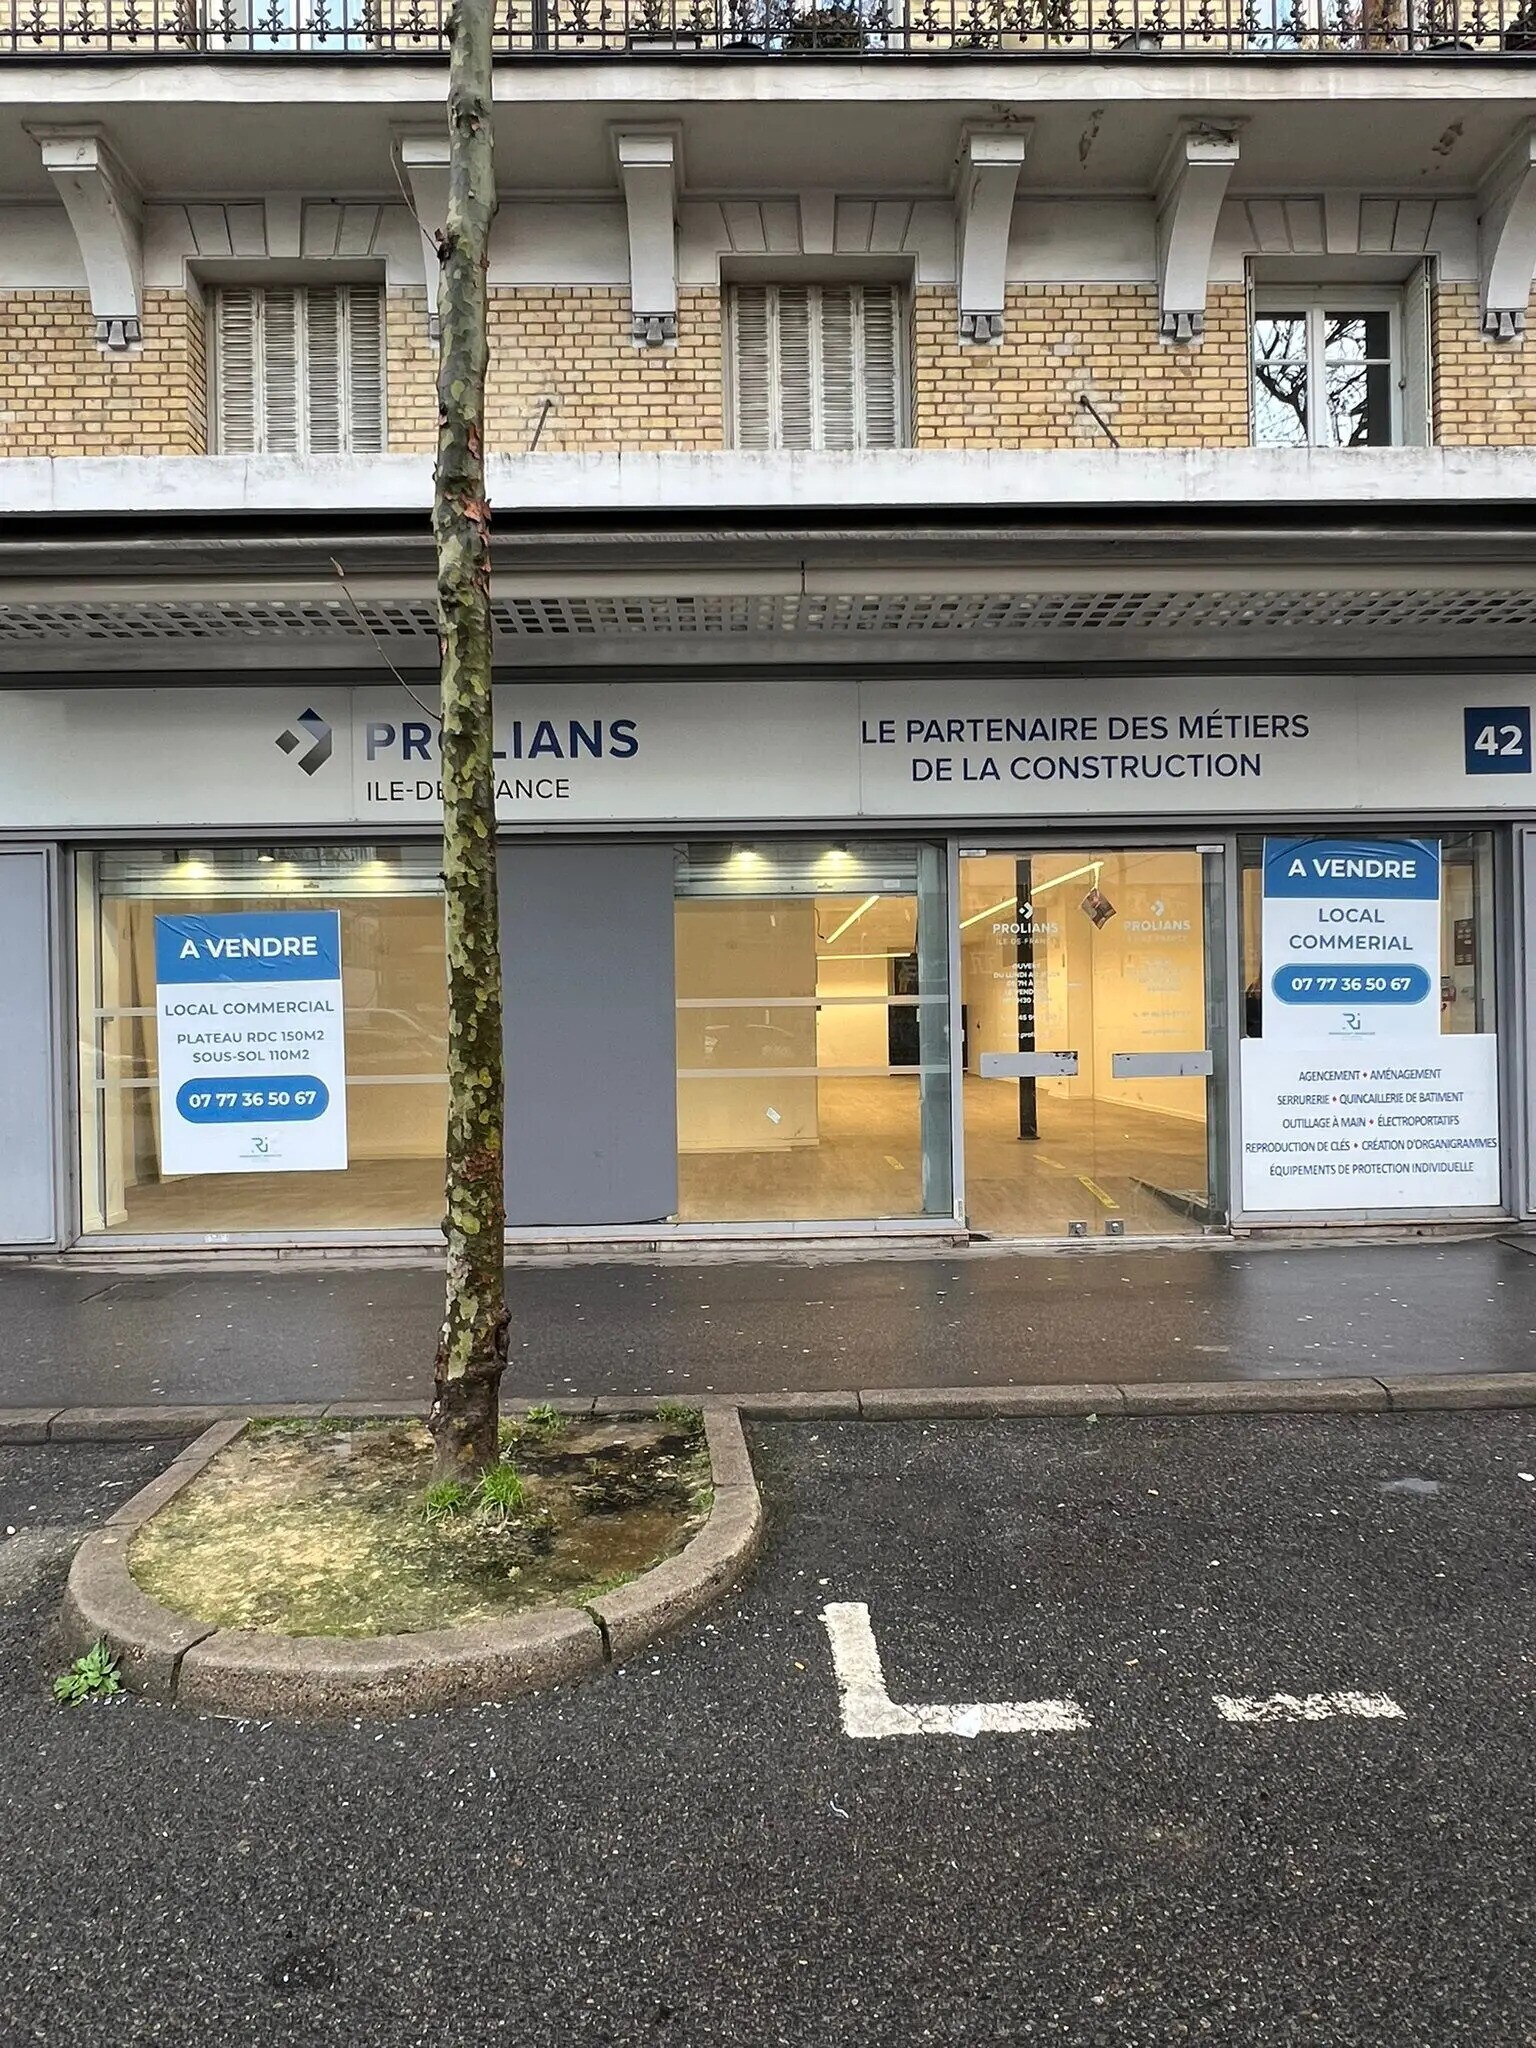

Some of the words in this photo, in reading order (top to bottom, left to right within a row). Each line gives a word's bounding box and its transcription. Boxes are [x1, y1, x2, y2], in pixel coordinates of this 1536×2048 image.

[861, 719, 897, 744] LE
[905, 717, 1098, 744] PARTENAIRE
[1108, 715, 1169, 741] DES
[1178, 709, 1310, 739] MÉTIERS
[1474, 725, 1524, 757] 42
[911, 757, 952, 782] DE
[961, 757, 1001, 781] LA
[1009, 753, 1262, 781] CONSTRUCTION
[1287, 859, 1308, 877] A
[1312, 858, 1417, 879] VENDRE
[1318, 907, 1385, 924] LOCAL
[992, 922, 1059, 934] PROLIANS
[1123, 919, 1191, 931] PROLIANS
[179, 939, 201, 959] A
[205, 935, 318, 959] VENDRE
[1289, 934, 1413, 951] COMMERIAL
[1291, 977, 1312, 991] 07
[1316, 977, 1337, 991] 77
[1340, 977, 1361, 991] 36
[1365, 977, 1386, 991] 50
[1390, 977, 1411, 991] 67
[164, 1003, 218, 1017] LOCAL
[222, 1000, 334, 1015] COMMERCIAL
[177, 1032, 242, 1044] PLATEAU
[247, 1031, 277, 1043] RDC
[281, 1030, 325, 1042] 150M2
[192, 1051, 265, 1063] SOUS-SOL
[270, 1049, 310, 1061] 110M2
[1298, 1070, 1361, 1082] AGENCEMENT
[1369, 1067, 1442, 1080] AMÉNAGEMENT
[189, 1093, 212, 1108] 07
[215, 1093, 238, 1107] 77
[241, 1092, 264, 1107] 36
[267, 1091, 290, 1106] 50
[294, 1090, 317, 1105] 67
[1277, 1094, 1330, 1105] SERRURERIE
[1339, 1093, 1404, 1105] QUINCAILLERIE
[1405, 1093, 1417, 1103] DE
[1282, 1117, 1331, 1129] OUTILLAGE
[1332, 1115, 1340, 1128] À
[1340, 1117, 1366, 1128] MAIN
[1377, 1114, 1460, 1127] ÉLECTROPORTATIFS
[1245, 1142, 1316, 1153] REPRODUCTION
[1317, 1141, 1329, 1152] DE
[1330, 1138, 1350, 1151] CLÉS
[1361, 1138, 1405, 1150] CRÉATION
[1406, 1138, 1497, 1150] D'ORGANIGRAMMES
[1269, 1163, 1336, 1177] ÉQUIPEMENTS
[1338, 1164, 1350, 1175] DE
[1352, 1163, 1410, 1174] PROTECTION
[1412, 1161, 1474, 1173] INDIVIDUELLE
